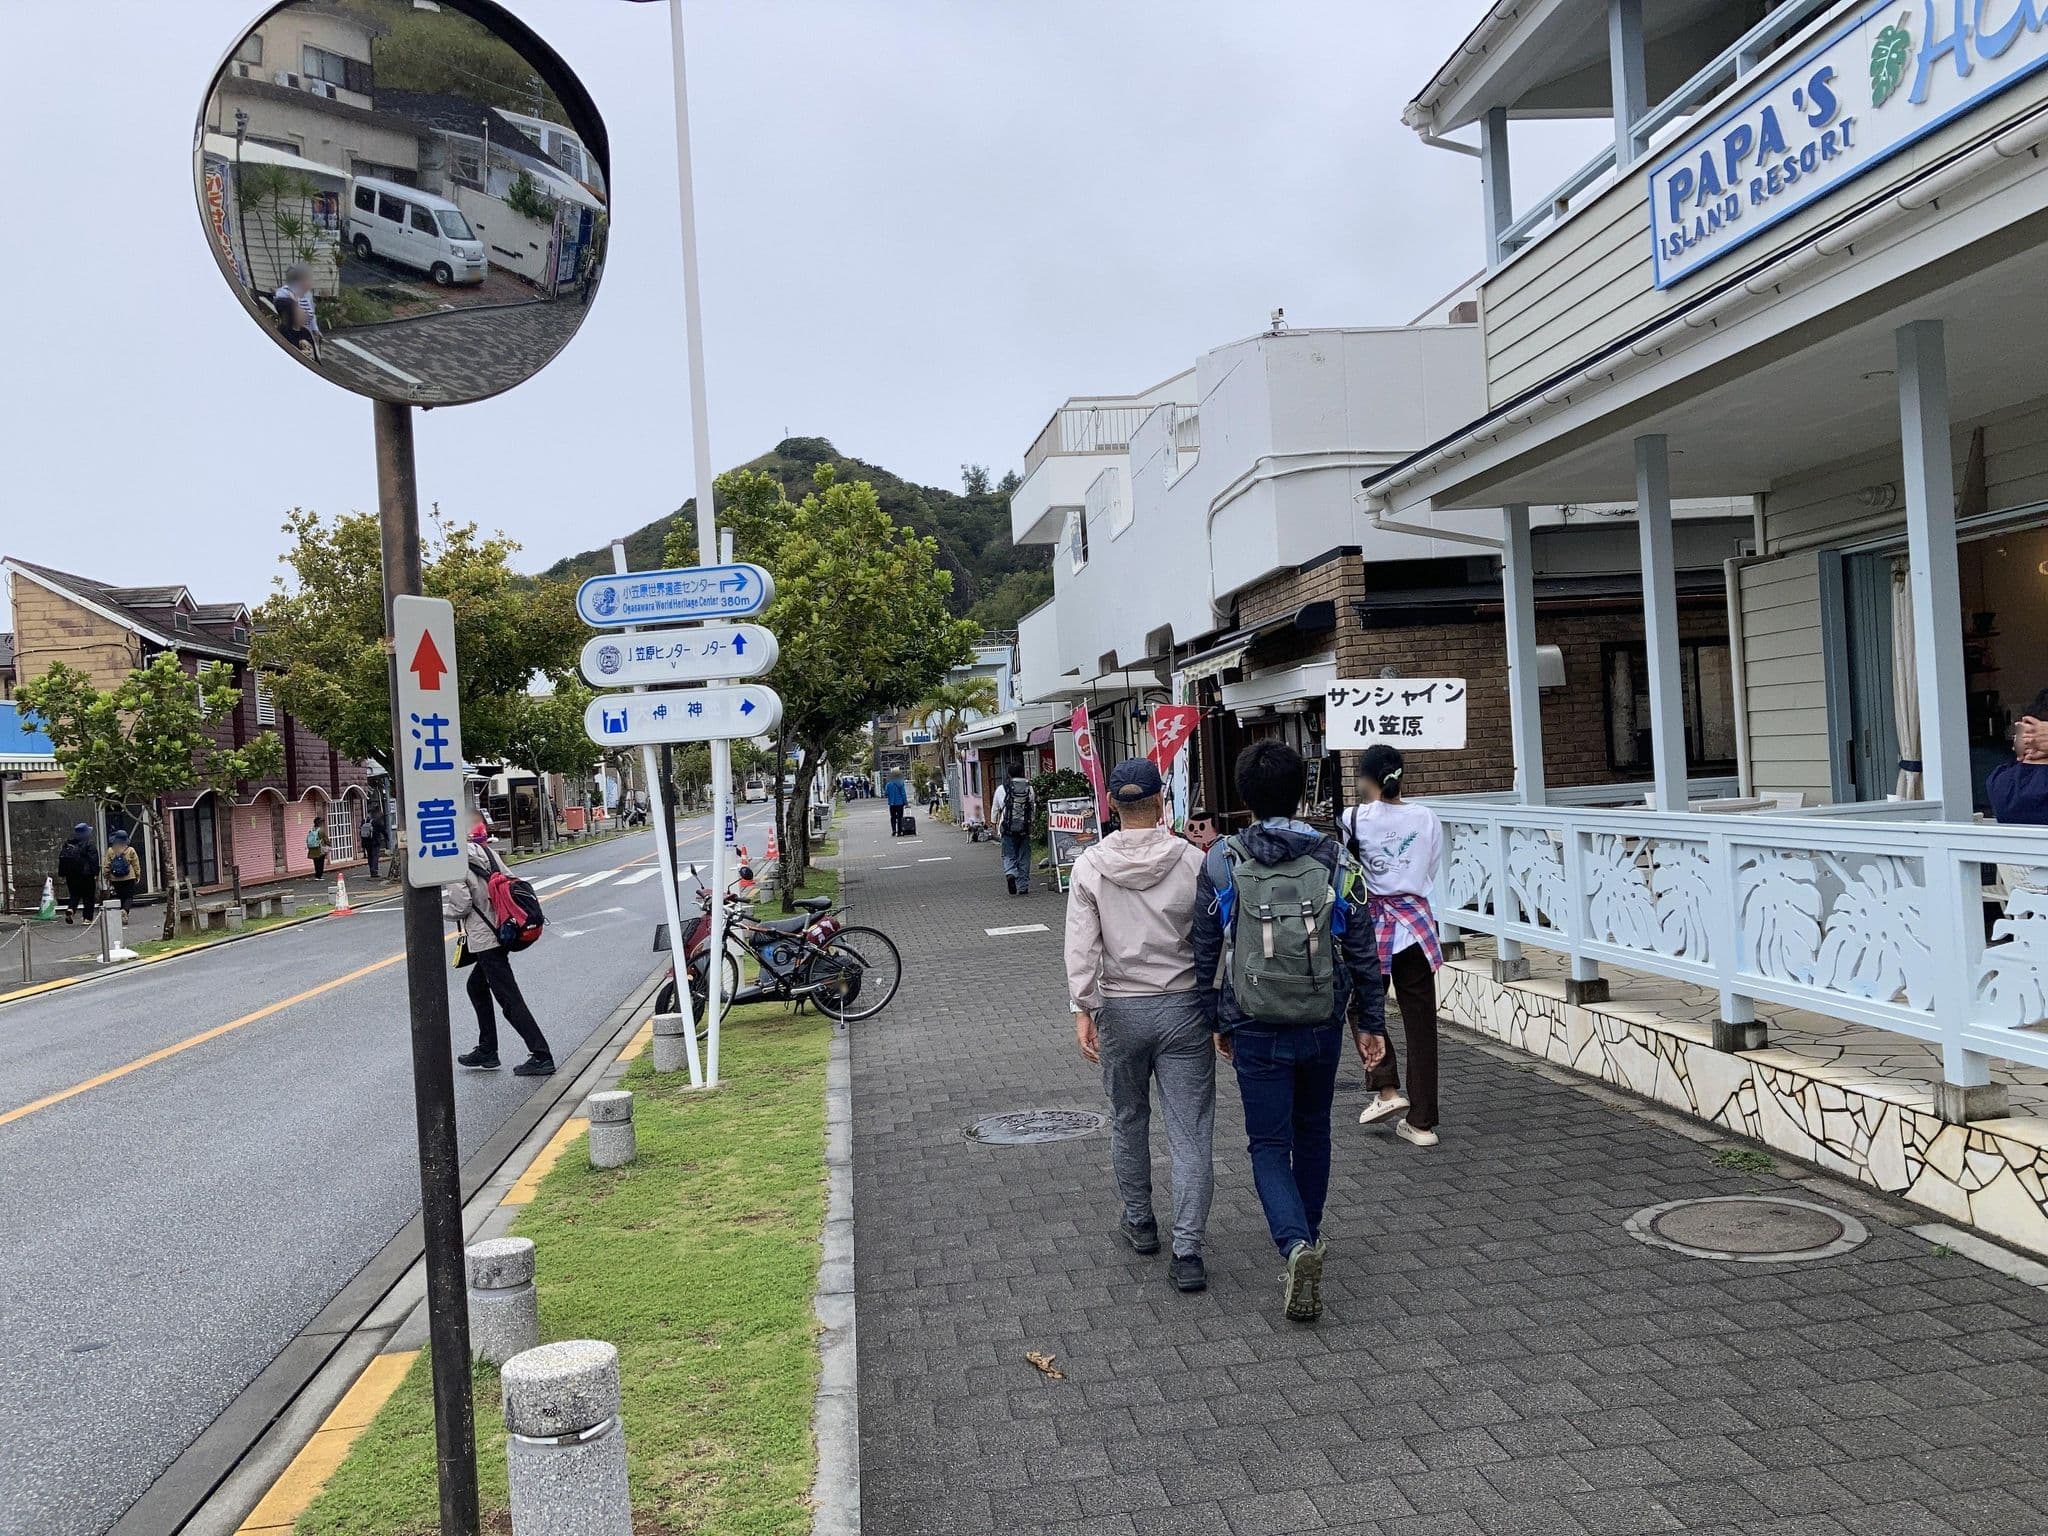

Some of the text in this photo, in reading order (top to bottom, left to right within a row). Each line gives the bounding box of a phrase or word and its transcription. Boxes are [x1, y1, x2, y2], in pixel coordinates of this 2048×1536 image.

[1667, 65, 1839, 223] PAPA'S
[1660, 116, 1857, 261] ISLAND RESORT
[622, 595, 718, 614] Ogasawara World Heritage Center
[720, 596, 750, 607] 380m
[1327, 682, 1465, 709] サンシャイン
[1353, 714, 1424, 737] 小笠原
[410, 712, 459, 858] 注意
[1049, 815, 1083, 830] LUNCH
